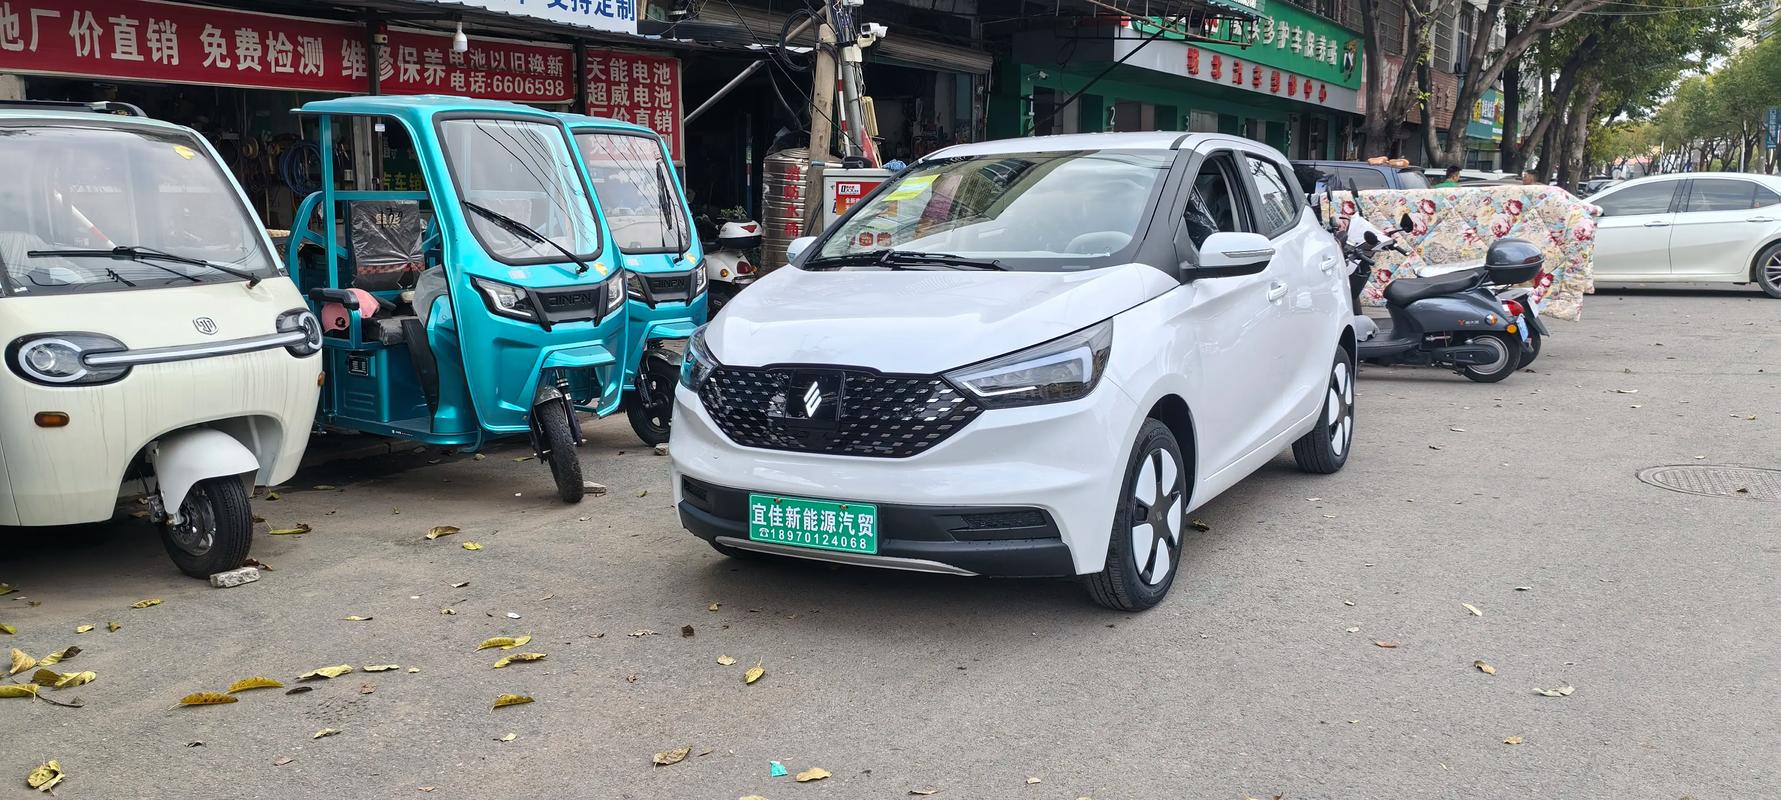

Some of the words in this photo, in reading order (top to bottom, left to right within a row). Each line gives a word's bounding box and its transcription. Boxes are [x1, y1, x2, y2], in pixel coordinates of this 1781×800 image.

[200, 23, 324, 77] 免费检测
[449, 47, 564, 77] 电池以旧换新
[450, 70, 564, 97] 电话:6606598
[586, 57, 671, 87] 天能电池
[587, 83, 673, 110] 超威电池
[752, 503, 874, 537] 宜佳新能源汽贸
[771, 528, 867, 549] 18970124068
